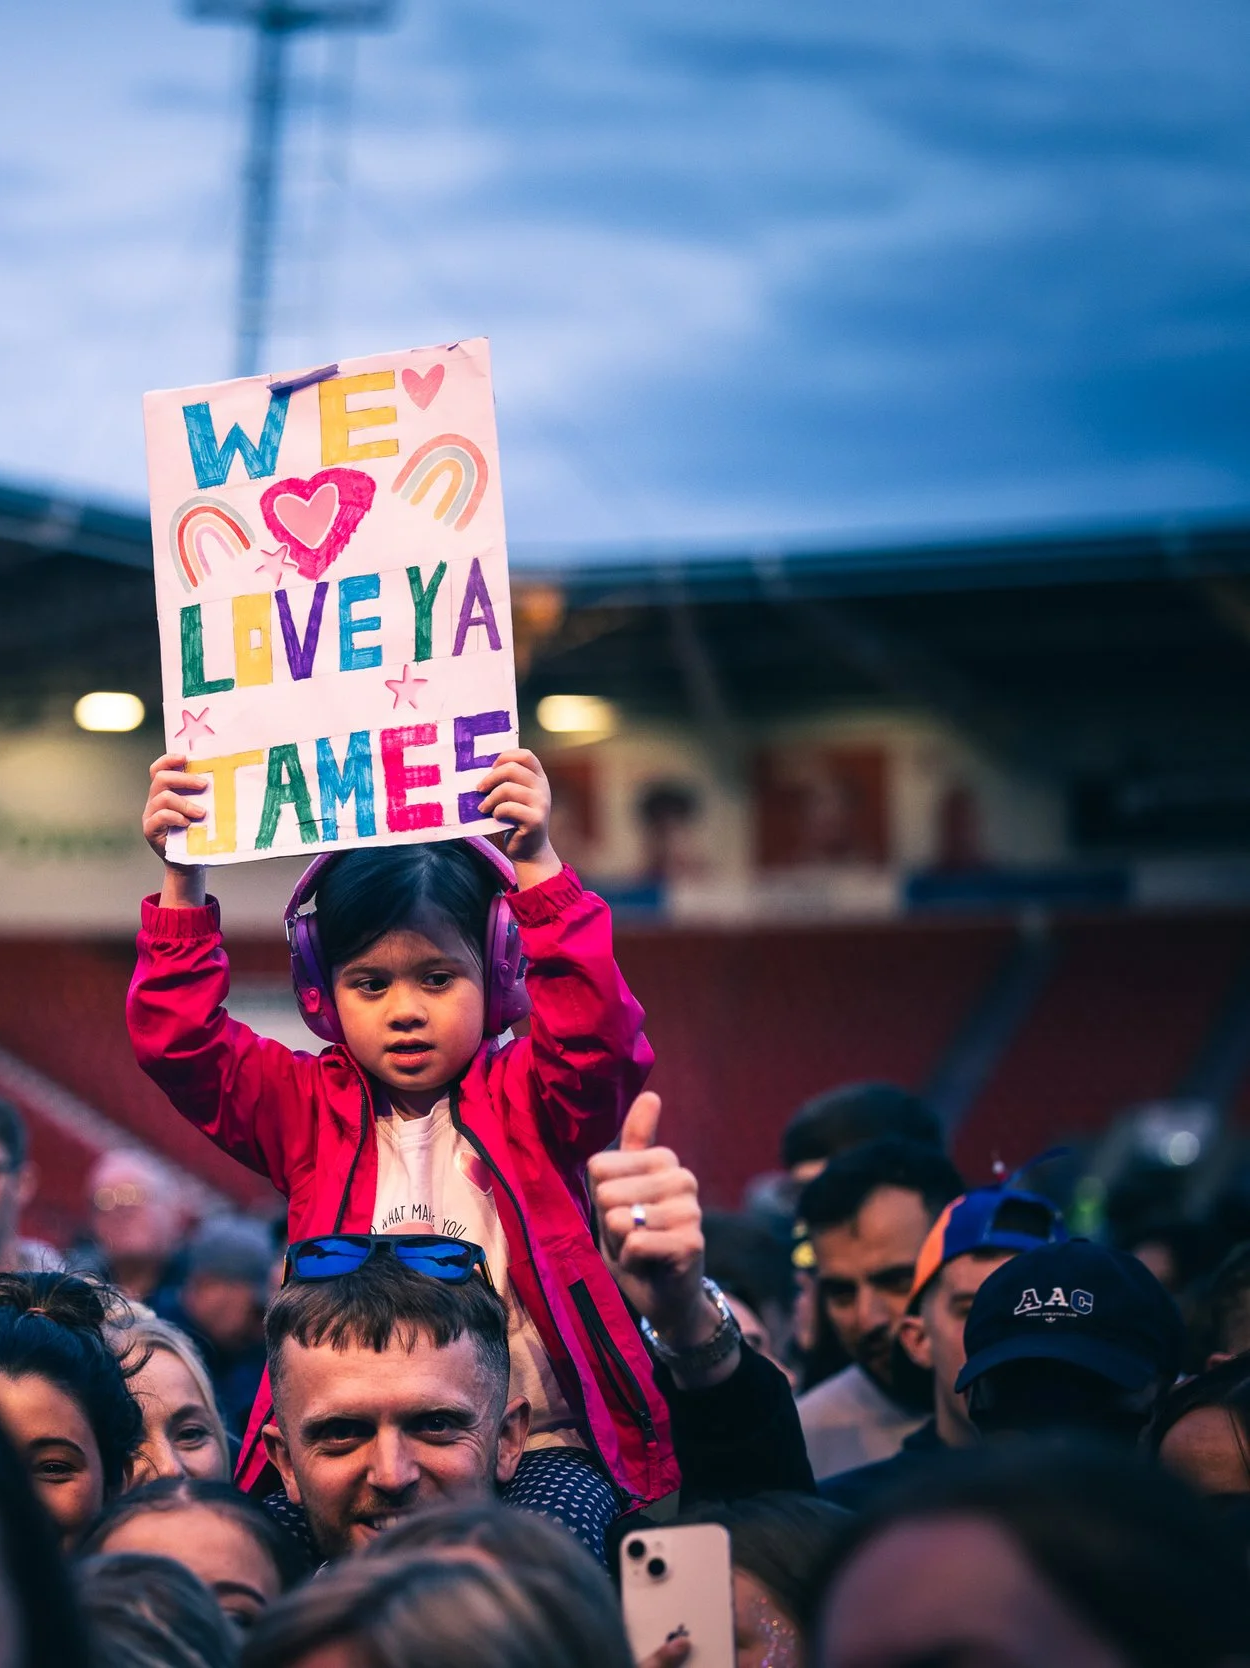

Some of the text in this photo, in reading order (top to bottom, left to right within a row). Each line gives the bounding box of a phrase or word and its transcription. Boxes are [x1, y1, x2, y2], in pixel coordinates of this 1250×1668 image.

[182, 370, 398, 489] WE
[179, 557, 502, 698] LOVE YA
[382, 1205, 405, 1230] WHAT
[441, 1218, 467, 1239] YOU
[1014, 1287, 1094, 1315] AAC
